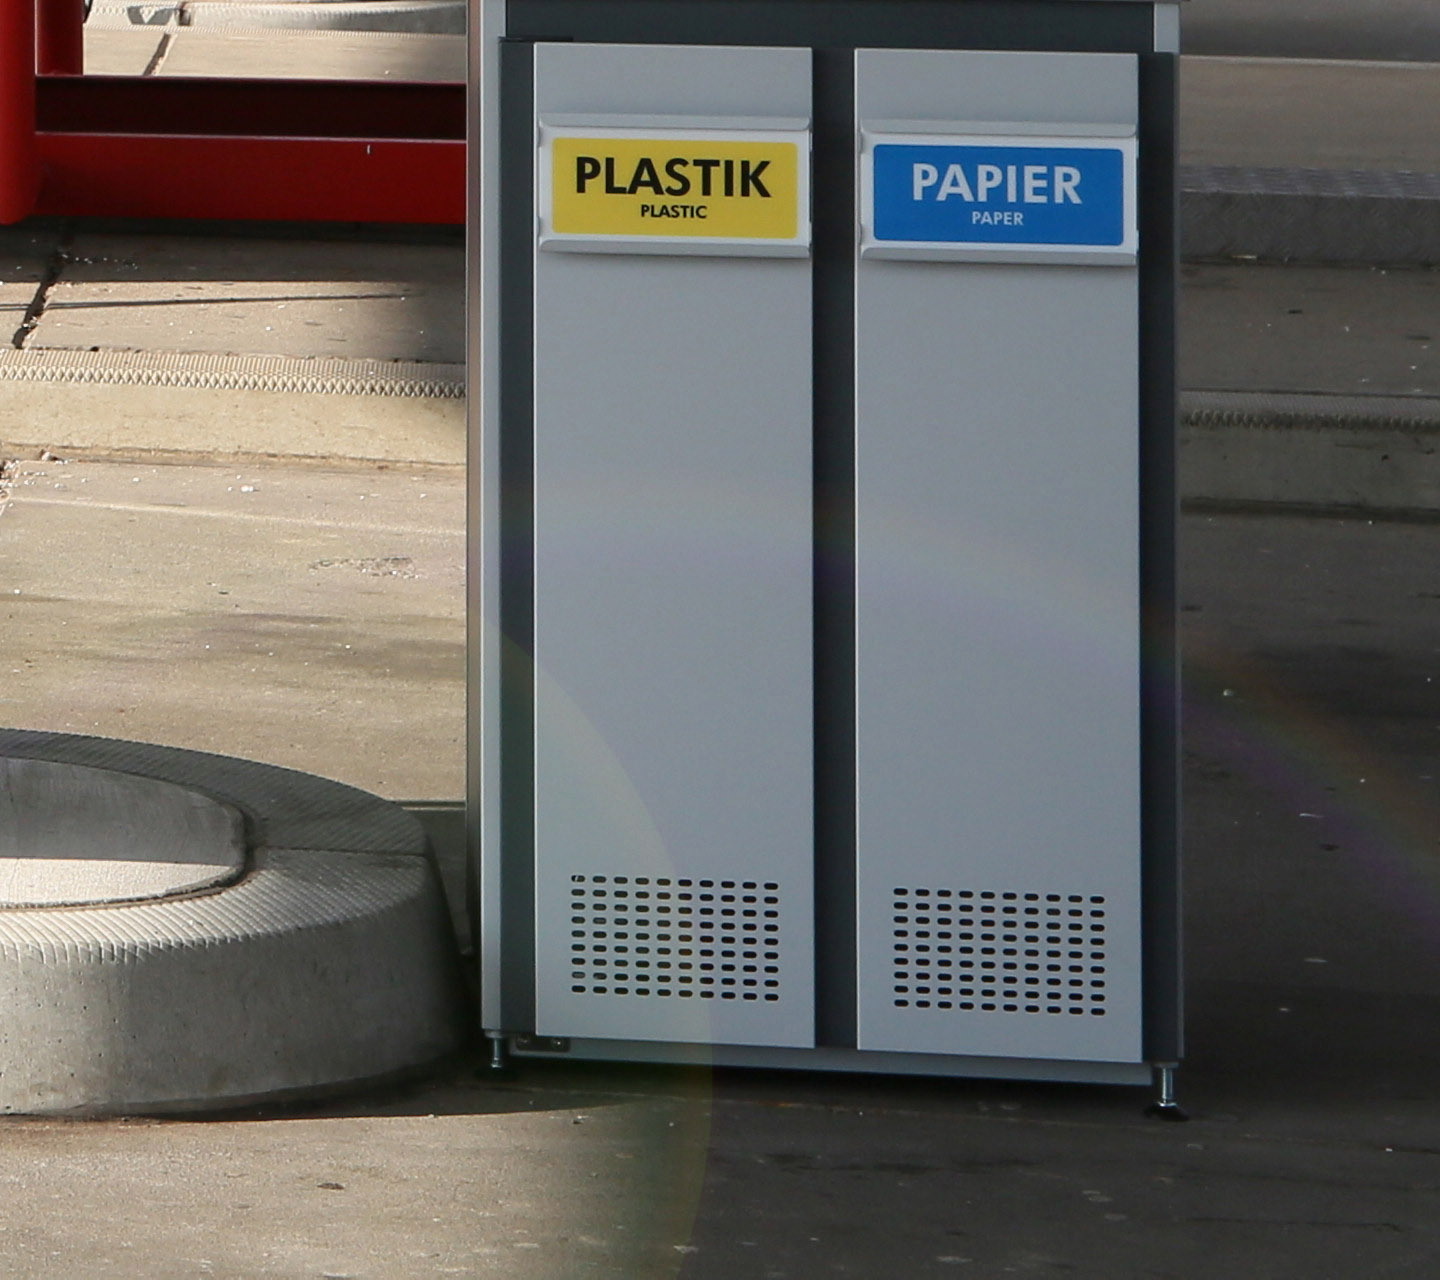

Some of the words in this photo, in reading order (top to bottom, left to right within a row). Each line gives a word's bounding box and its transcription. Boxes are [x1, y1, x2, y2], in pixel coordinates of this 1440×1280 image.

[575, 156, 772, 199] PLASTIK
[912, 163, 1082, 205] PAPIER
[640, 205, 708, 220] PLASTIC
[971, 211, 1024, 227] PAPER
